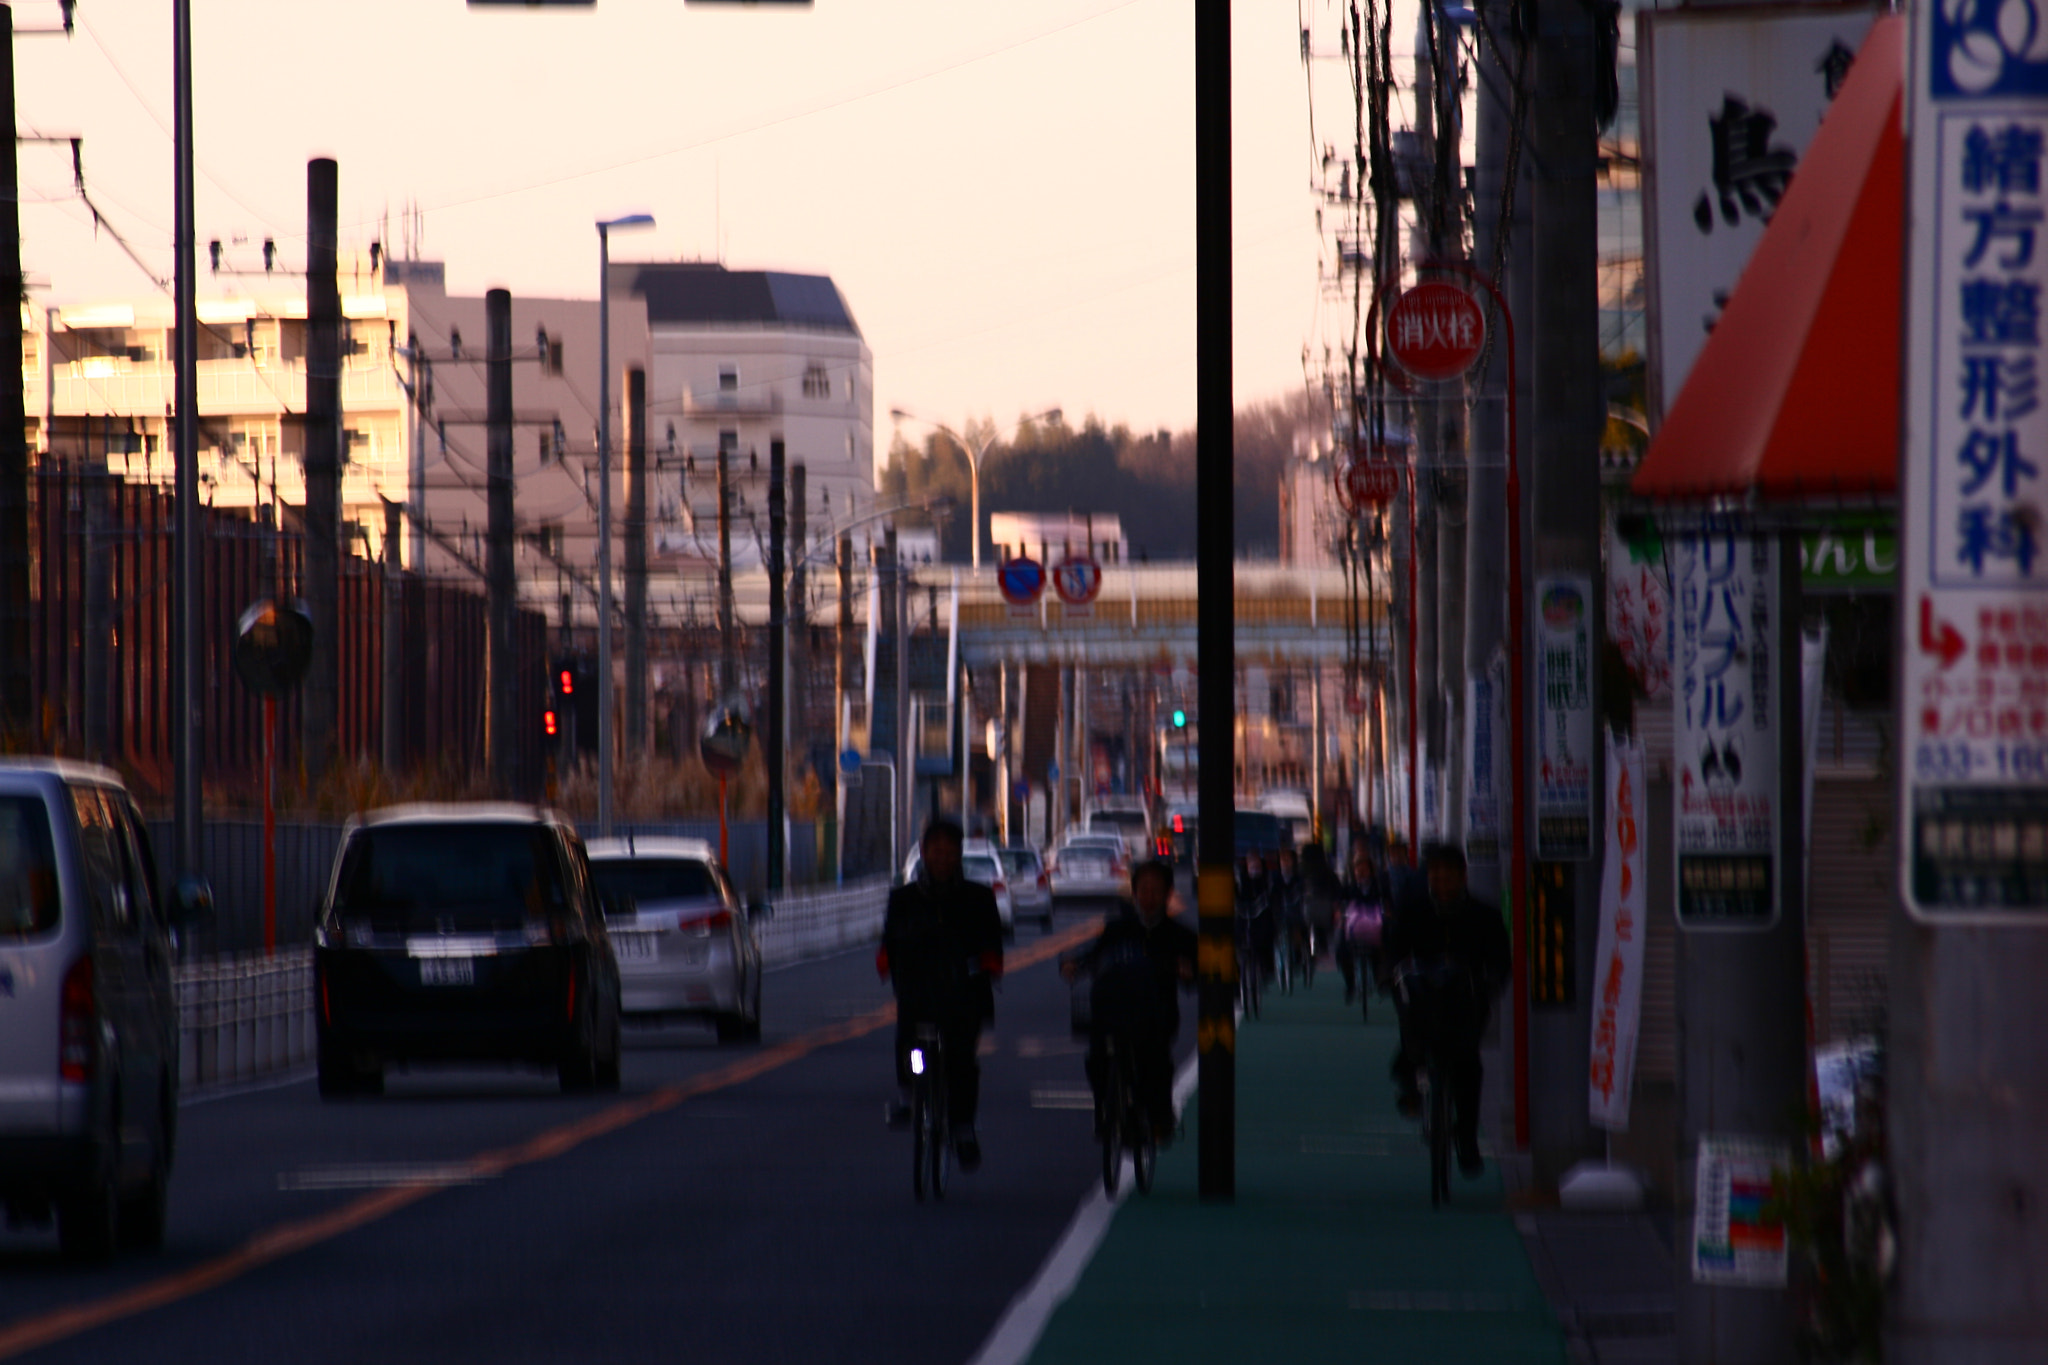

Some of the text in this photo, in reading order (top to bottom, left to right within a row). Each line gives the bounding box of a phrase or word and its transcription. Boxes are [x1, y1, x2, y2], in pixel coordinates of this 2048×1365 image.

[1396, 308, 1477, 351] 消火栓
[1957, 123, 2045, 576] 緒方整形外科
[1352, 474, 1394, 496] 消火栓
